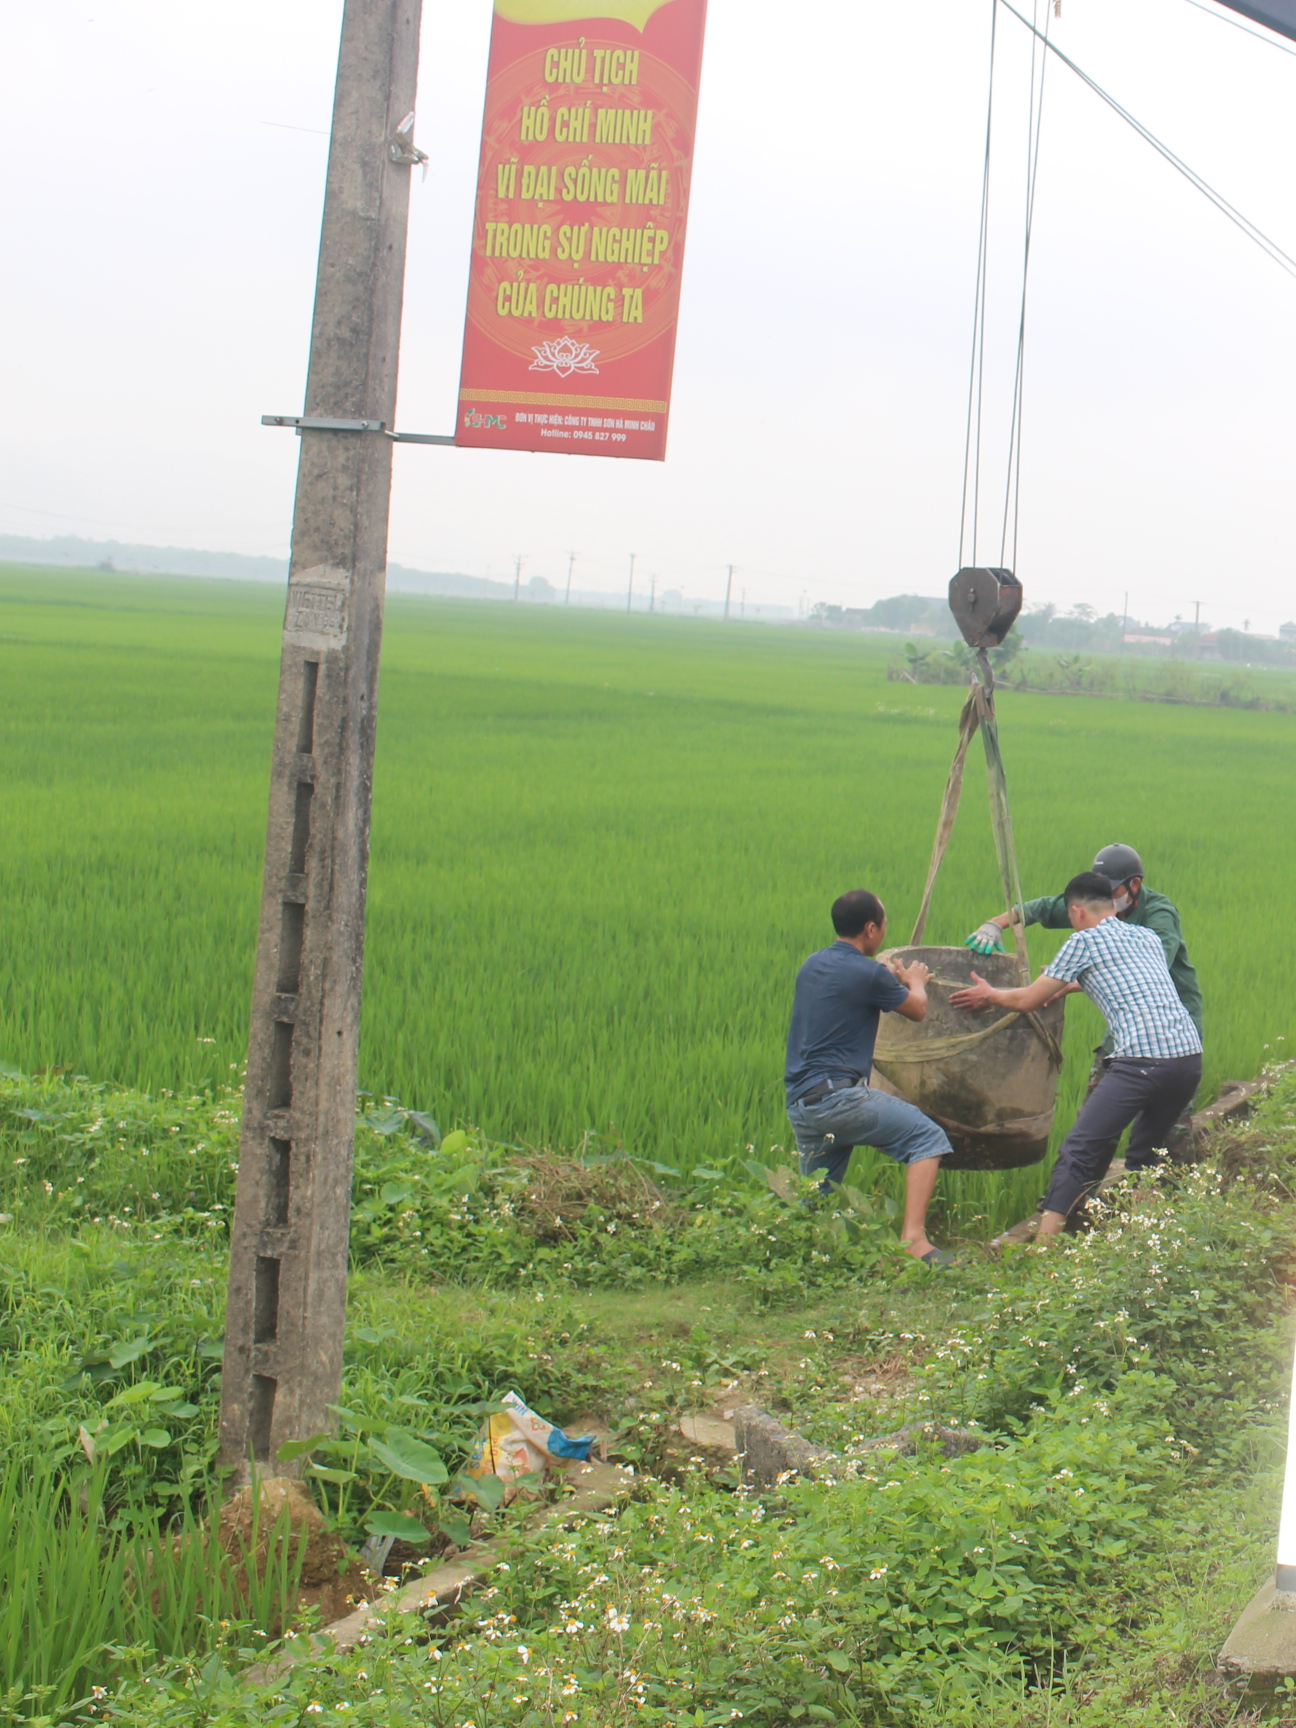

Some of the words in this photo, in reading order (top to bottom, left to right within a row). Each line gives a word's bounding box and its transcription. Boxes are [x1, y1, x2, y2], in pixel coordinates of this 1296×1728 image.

[543, 36, 588, 84] CHỦ
[593, 49, 640, 92] TỊCH
[520, 94, 549, 142] HỒ
[554, 100, 592, 143] CHÍ
[594, 108, 653, 145] MINH
[497, 157, 519, 200] VĨ
[520, 164, 557, 208] ĐẠI
[561, 154, 620, 203] SỐNG
[624, 162, 668, 206] MÃI
[485, 222, 552, 260] TRONG
[556, 222, 590, 269] SỰ
[590, 221, 669, 272] NGHIỆP
[496, 269, 538, 318] CỦA
[543, 277, 616, 322] CHÚNG
[621, 286, 644, 323] TA
[540, 428, 571, 439] Hotline:
[573, 430, 593, 440] 0945
[594, 431, 610, 441] 827
[611, 433, 627, 442] 999
[564, 414, 580, 426] CÔNG
[580, 416, 588, 426] TY
[588, 417, 602, 427] TNHH
[603, 417, 615, 428] SƠN
[615, 417, 624, 429] HÀ
[624, 419, 640, 430] MINH
